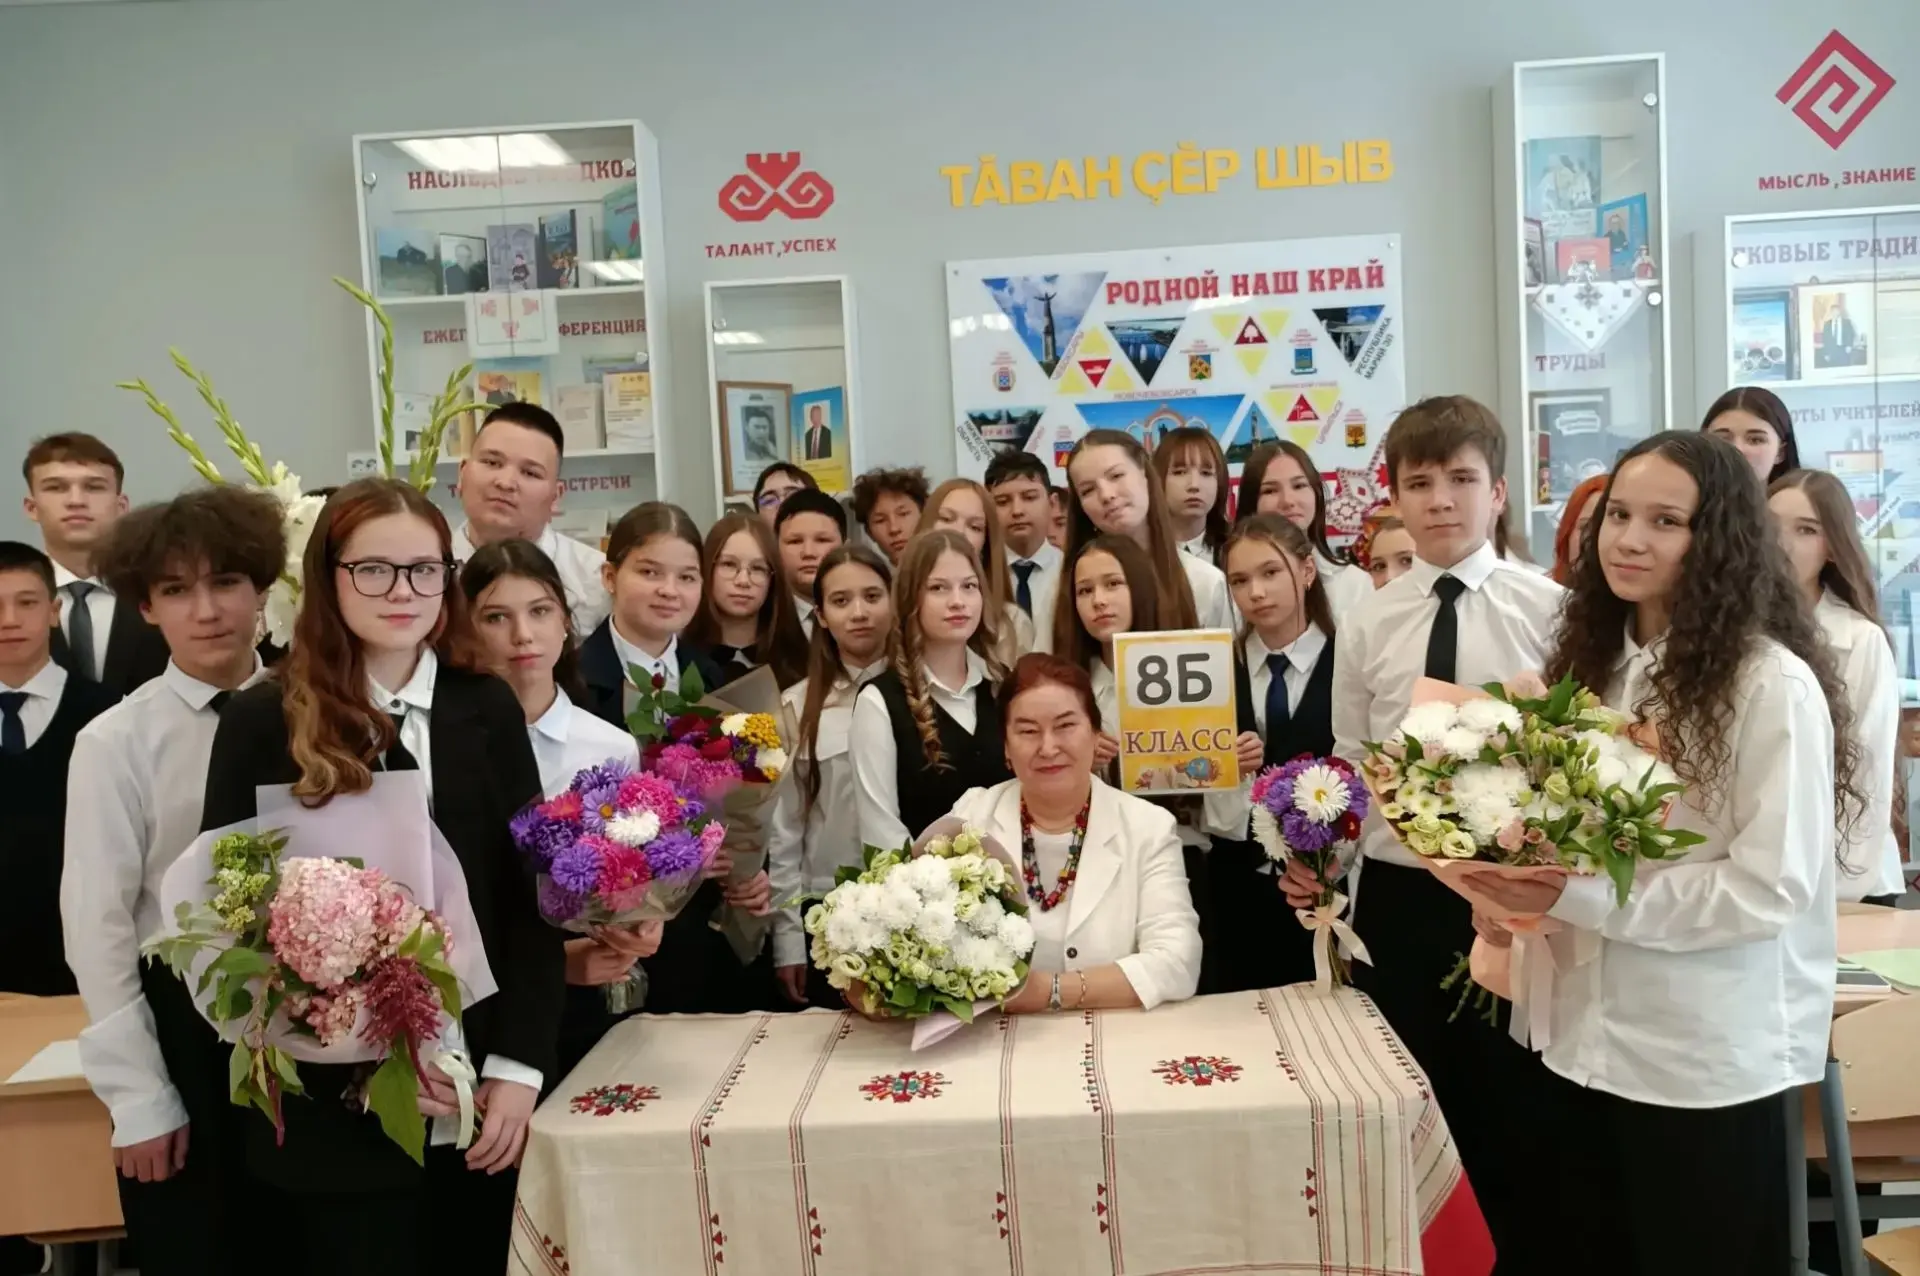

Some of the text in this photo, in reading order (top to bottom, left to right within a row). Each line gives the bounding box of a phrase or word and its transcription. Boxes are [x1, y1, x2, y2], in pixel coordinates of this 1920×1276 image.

[1254, 138, 1395, 190] ШЫВ
[1842, 166, 1917, 185] ЗНАНИЕ
[782, 237, 837, 254] УСПЕХ
[1732, 235, 1920, 266] КОВЫЕ ТРАДИ
[1105, 258, 1385, 306] РОДНОЙ НАШ КРАЙ
[558, 318, 647, 337] ФЕРЕНЦИЯ
[1354, 316, 1392, 376] РЕСПУБЛИКА
[1534, 351, 1606, 373] ТРУДЫ
[1136, 652, 1213, 706] 8Б
[1124, 727, 1233, 754] КЛАСС
